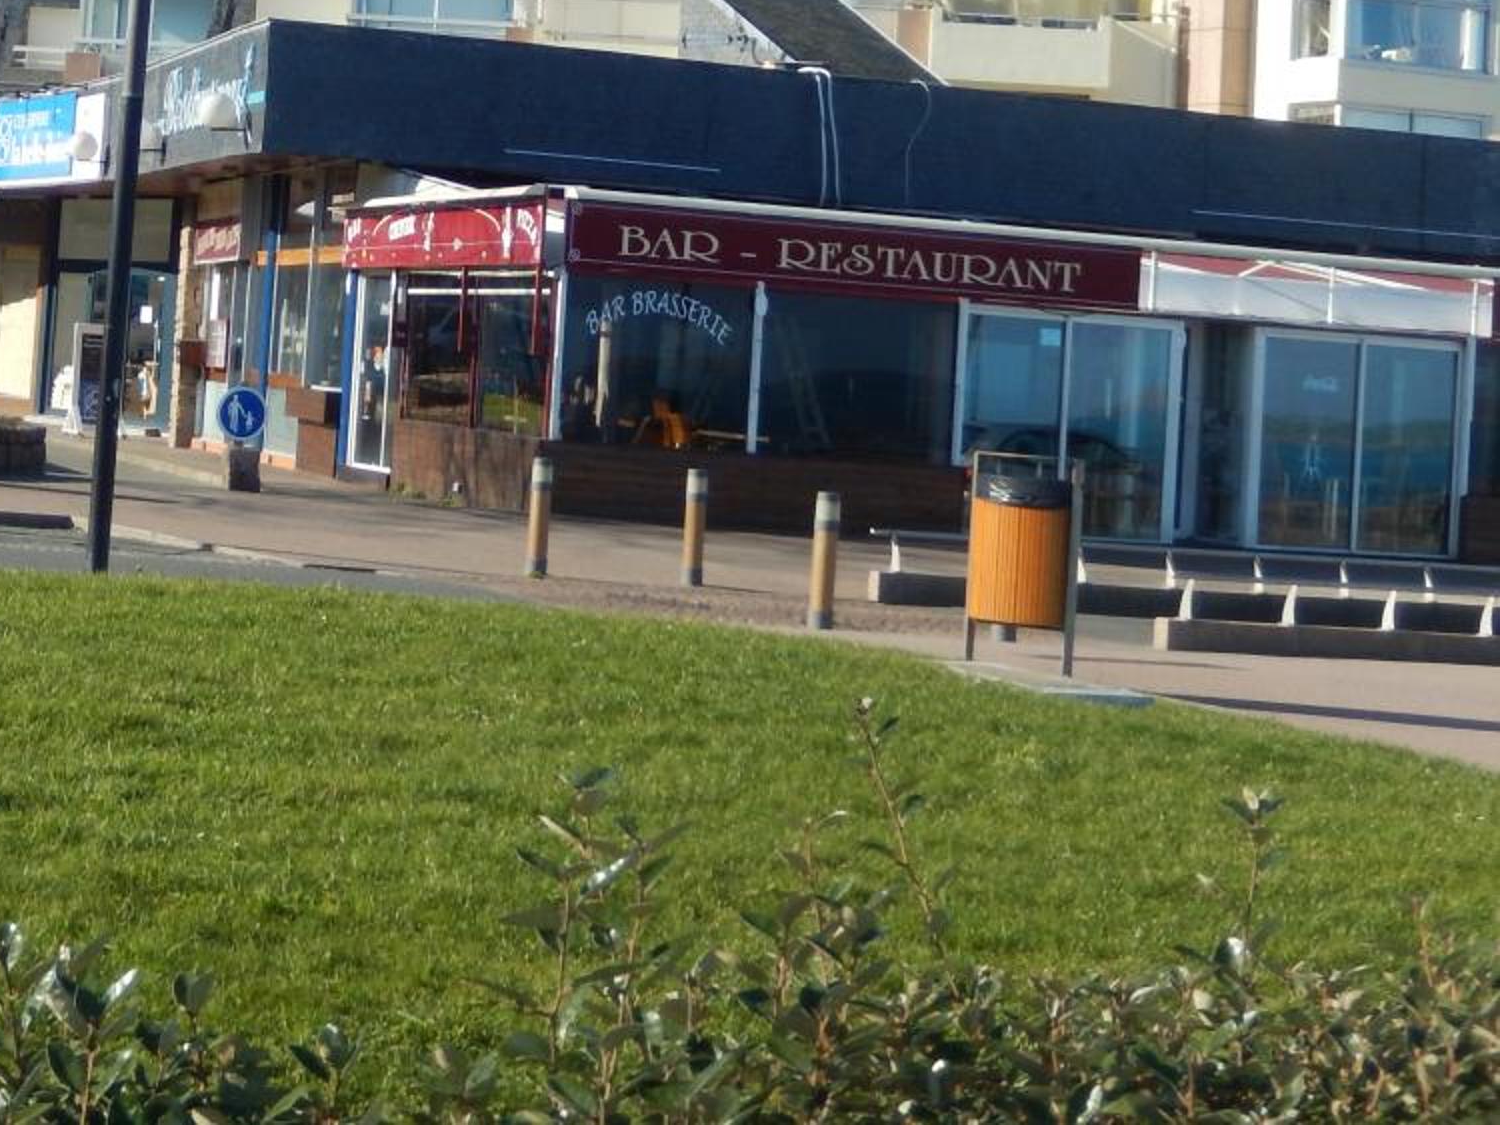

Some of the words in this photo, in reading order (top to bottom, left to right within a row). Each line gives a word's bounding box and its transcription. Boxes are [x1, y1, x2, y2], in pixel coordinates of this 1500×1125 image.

[617, 225, 721, 264] BAR
[776, 238, 1082, 293] RESTAURANT
[585, 295, 626, 335] BAR
[631, 289, 733, 346] BRASSERIE
